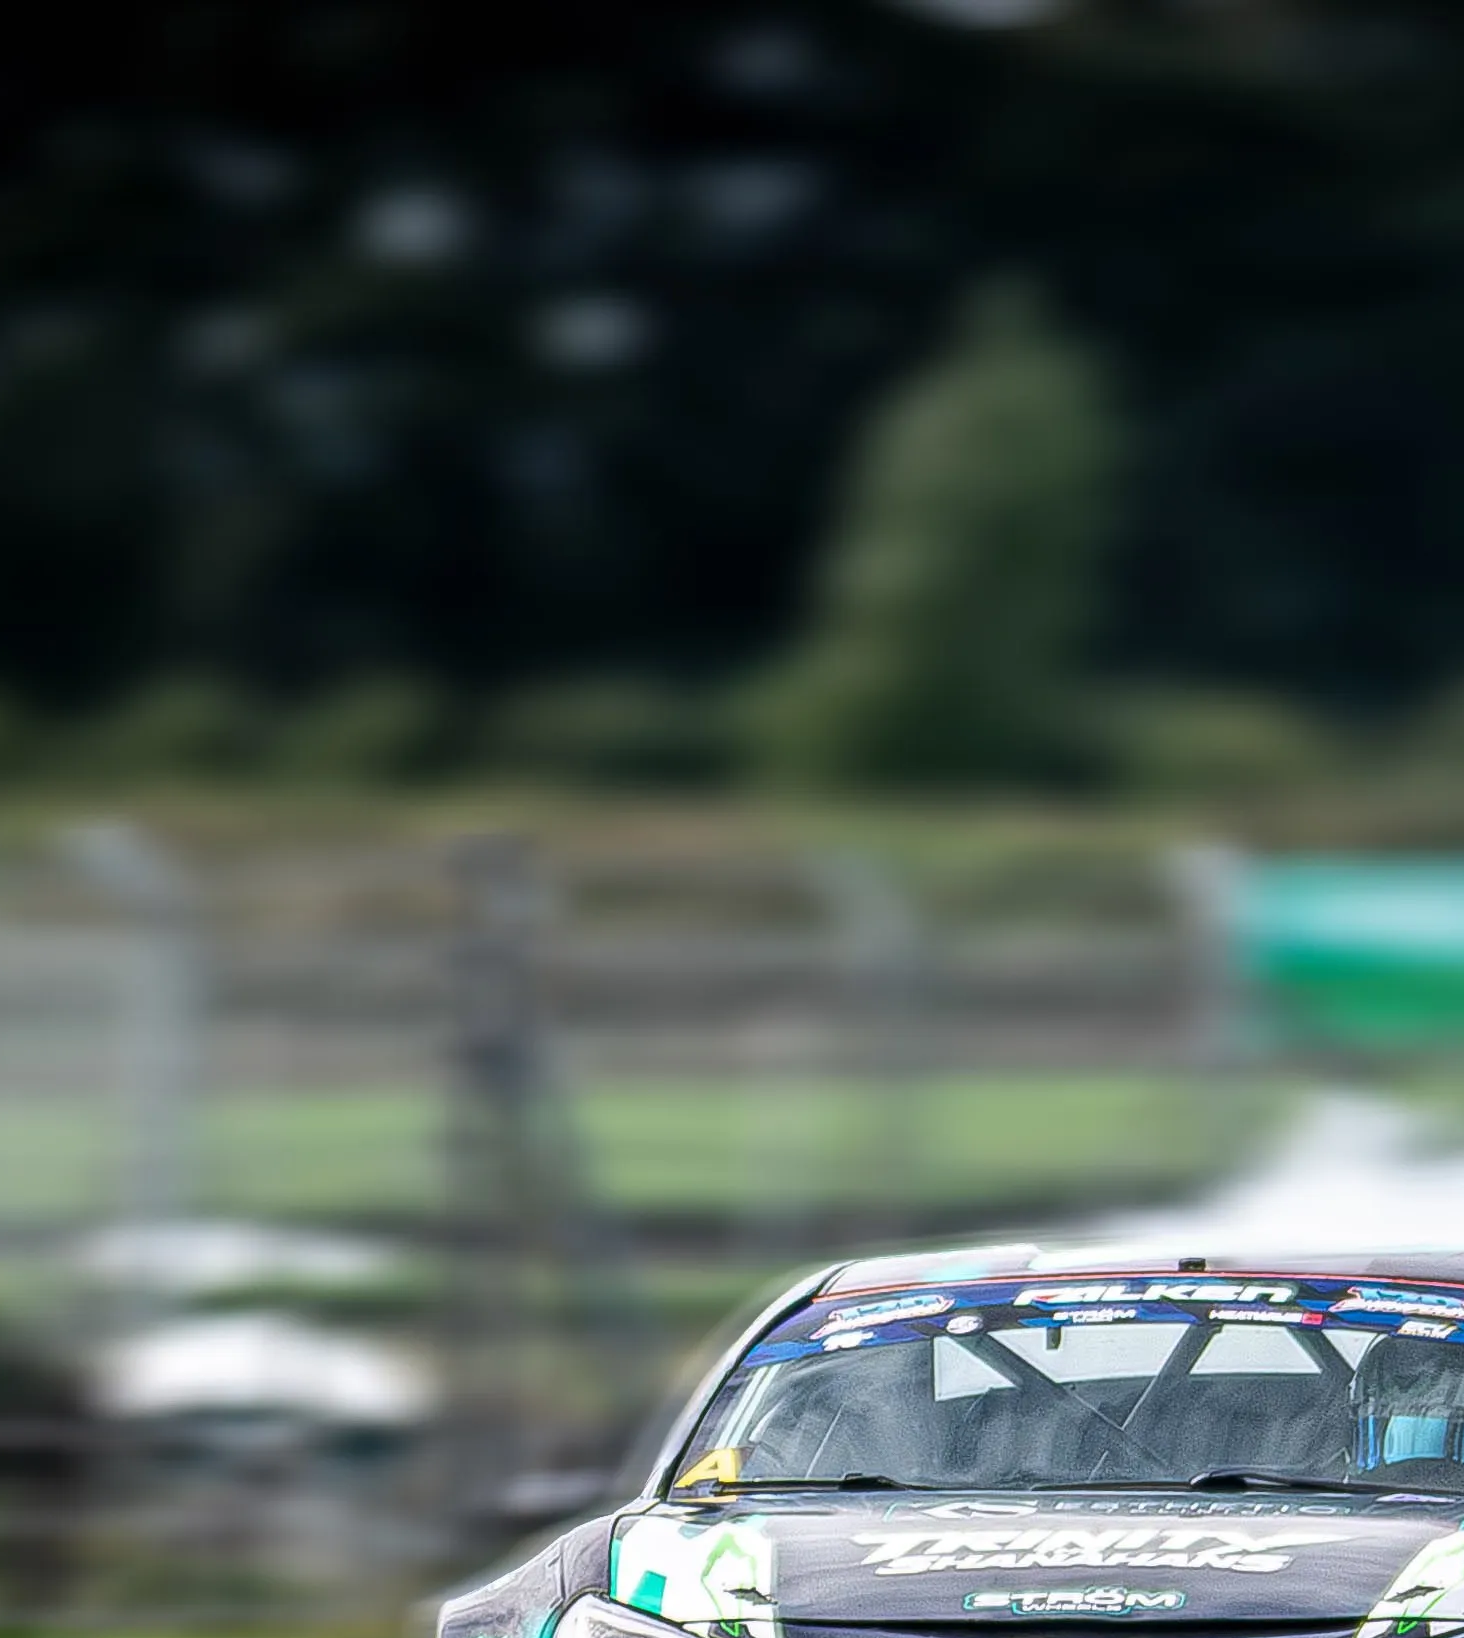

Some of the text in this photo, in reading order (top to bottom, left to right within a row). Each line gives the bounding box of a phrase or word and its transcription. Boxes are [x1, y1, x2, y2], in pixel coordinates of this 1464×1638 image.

[1013, 1284, 1293, 1306] FALKEN
[850, 1528, 1358, 1565] TRINITY
[974, 1587, 1178, 1608] STRÖM
